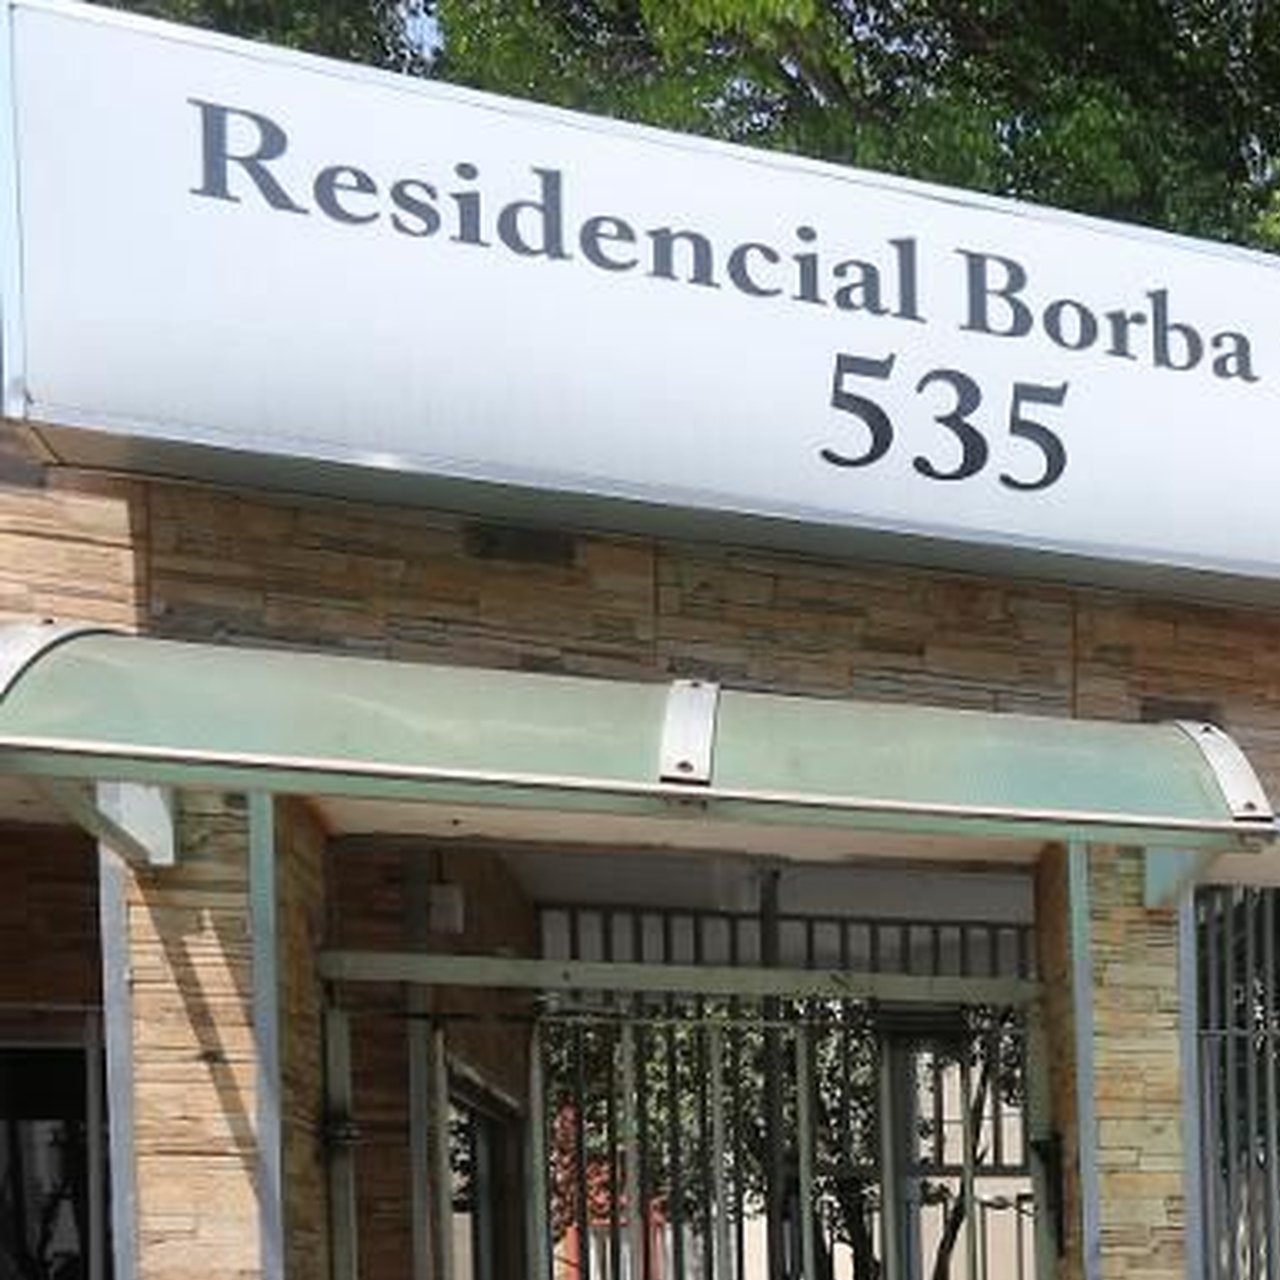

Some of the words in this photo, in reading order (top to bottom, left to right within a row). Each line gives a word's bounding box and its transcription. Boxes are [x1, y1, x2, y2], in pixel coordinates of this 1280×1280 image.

[191, 100, 924, 324] Residencial
[957, 249, 1258, 382] Borba
[820, 353, 1069, 492] 535
